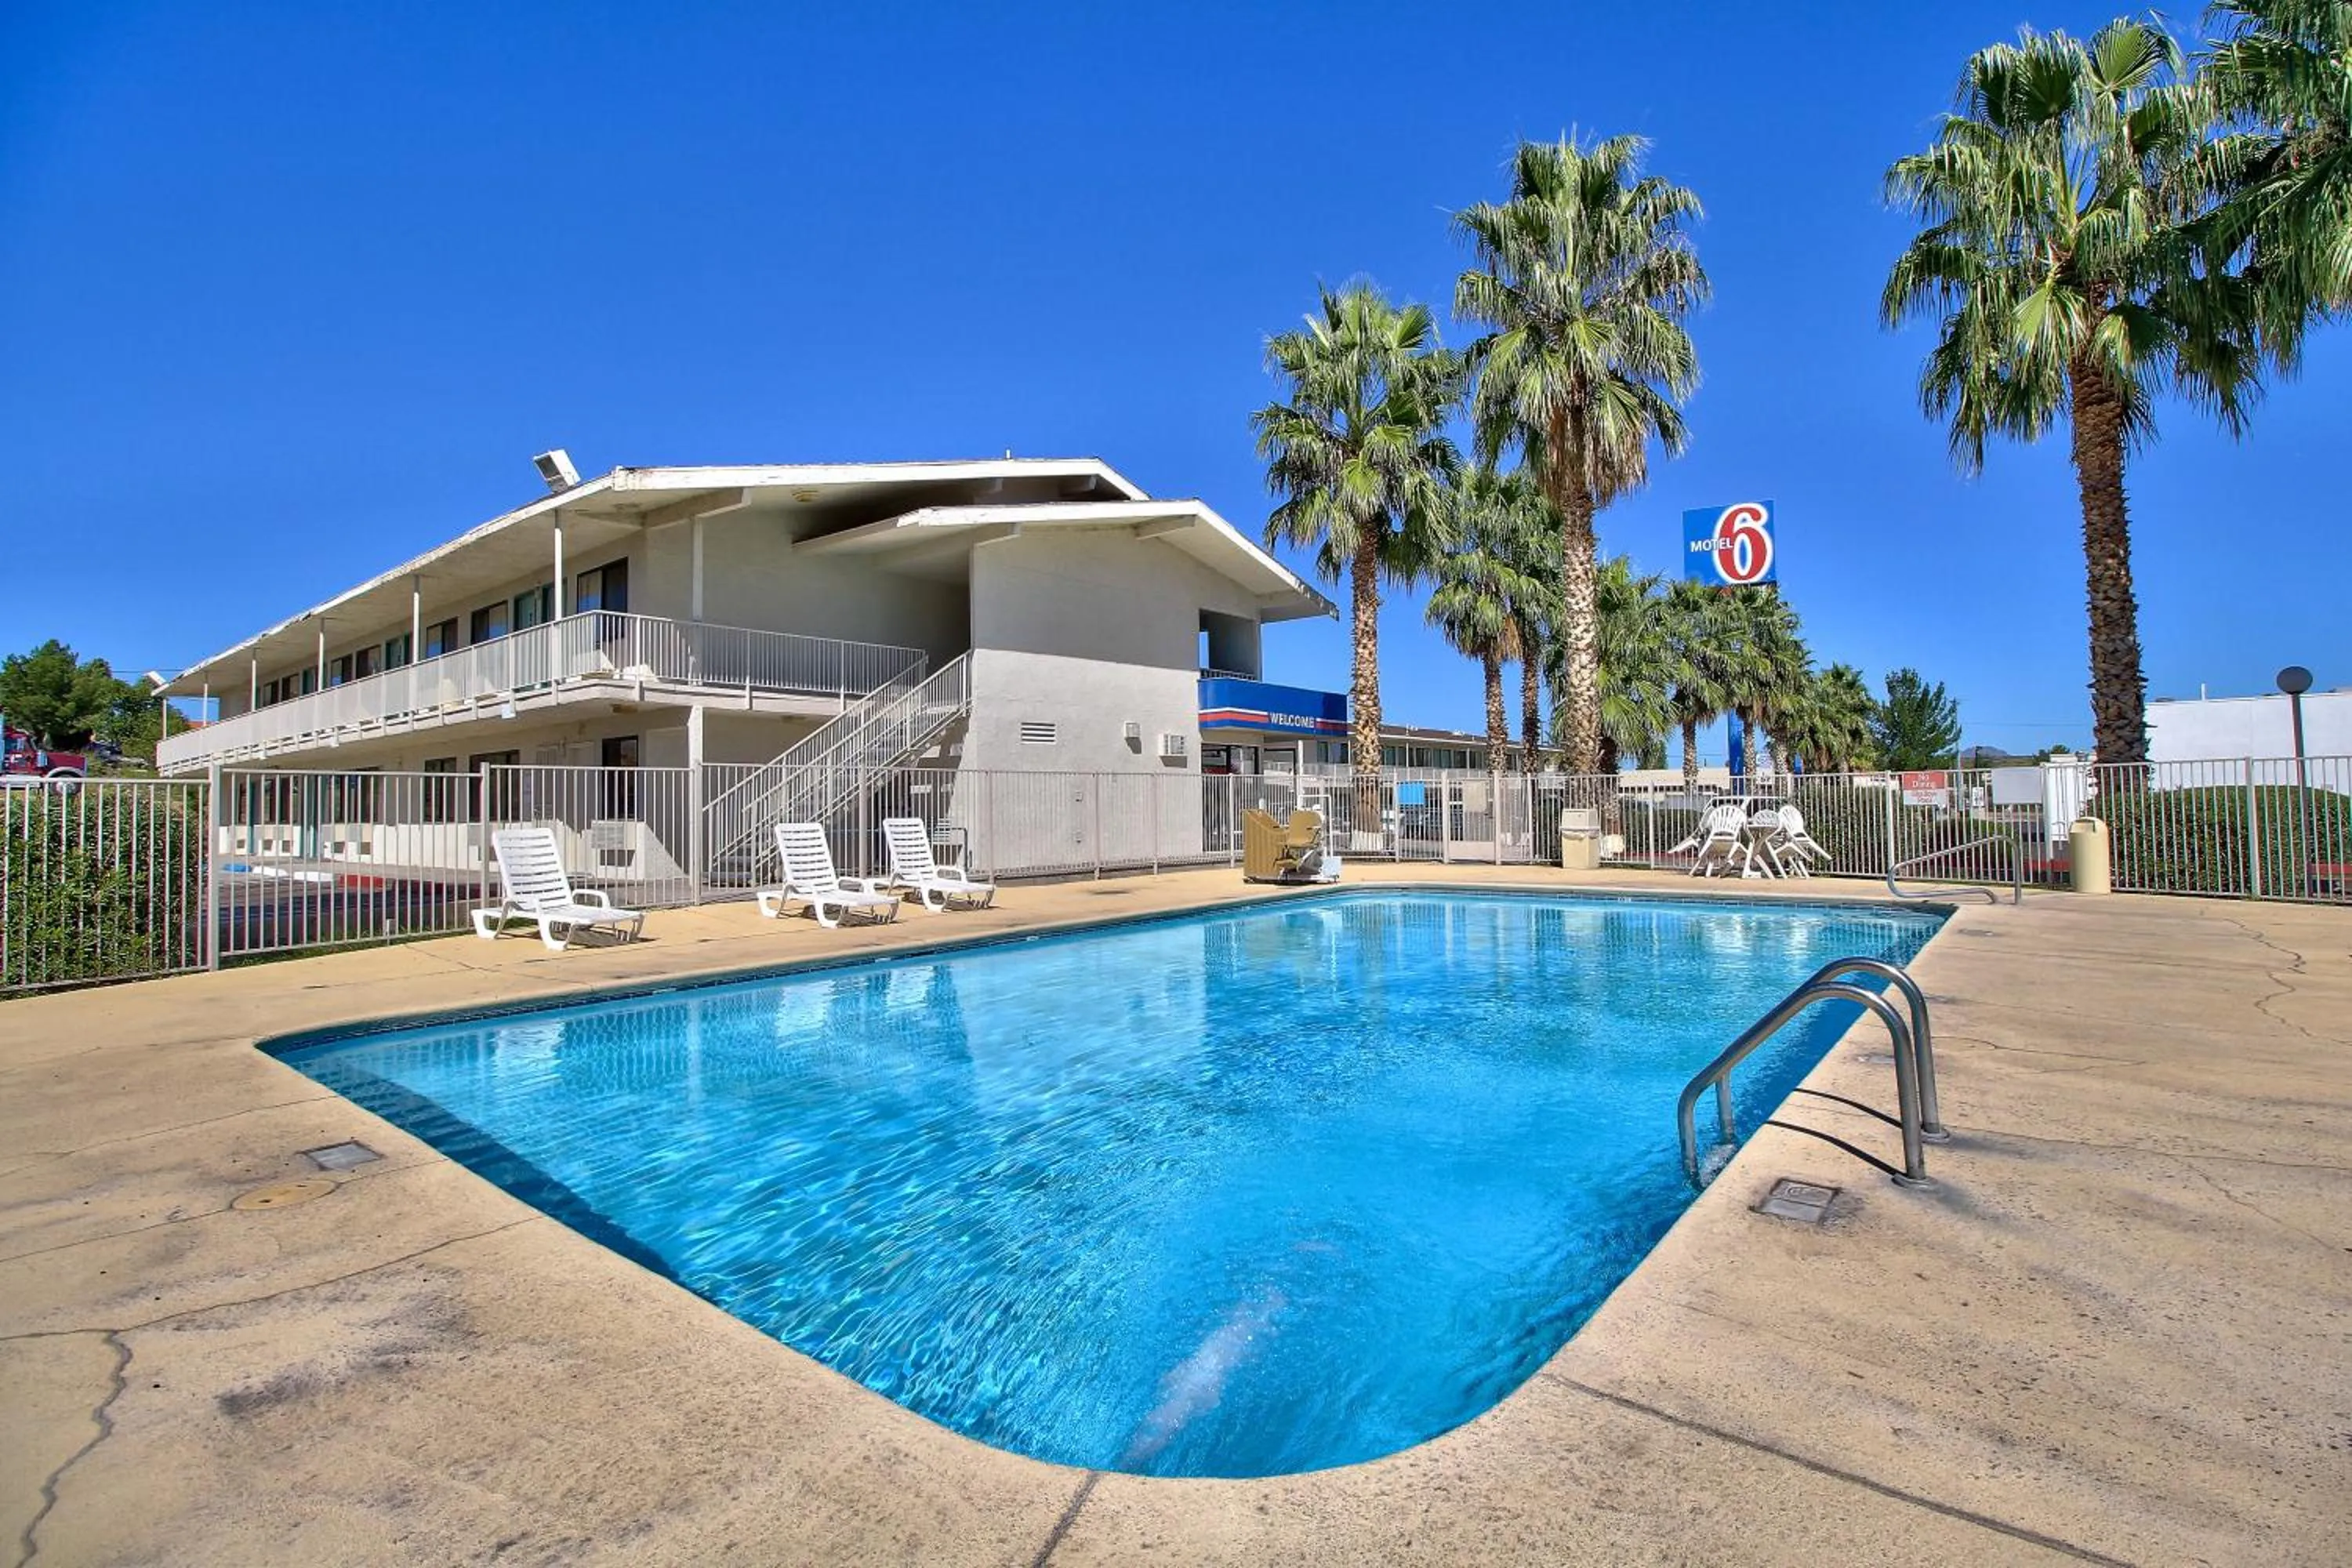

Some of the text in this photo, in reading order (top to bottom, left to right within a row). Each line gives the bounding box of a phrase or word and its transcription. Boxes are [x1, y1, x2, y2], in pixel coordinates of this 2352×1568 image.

[1690, 503, 1773, 583] MOTEL 6
[1270, 712, 1315, 728] WELCOME
